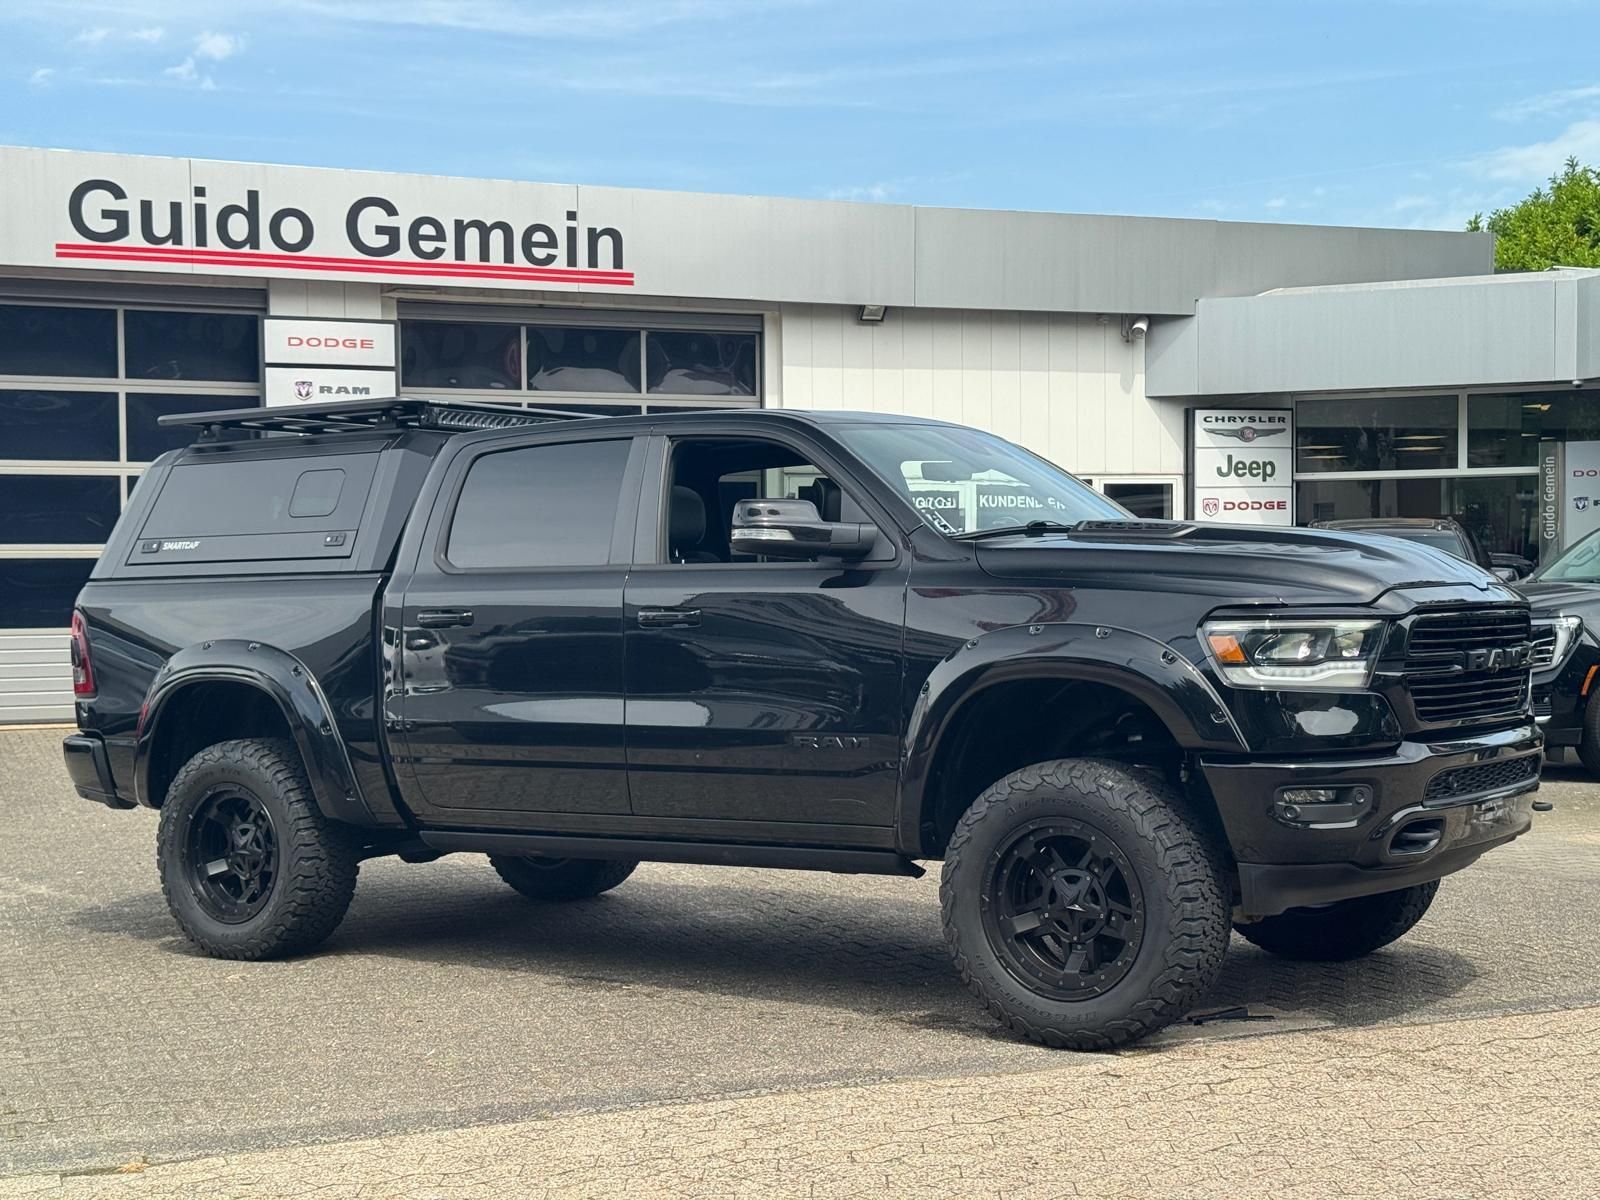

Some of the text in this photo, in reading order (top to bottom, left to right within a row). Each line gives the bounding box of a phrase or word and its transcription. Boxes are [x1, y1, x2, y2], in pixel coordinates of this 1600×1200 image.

[68, 179, 624, 270] Guido Gemein
[288, 336, 374, 349] DODGE
[319, 385, 370, 395] RAM
[1203, 415, 1286, 424] CHRYSLER
[1216, 454, 1276, 482] Jeep
[1543, 456, 1555, 540] Guido Gemein
[1223, 500, 1287, 511] DODGE
[793, 736, 870, 749] RAM
